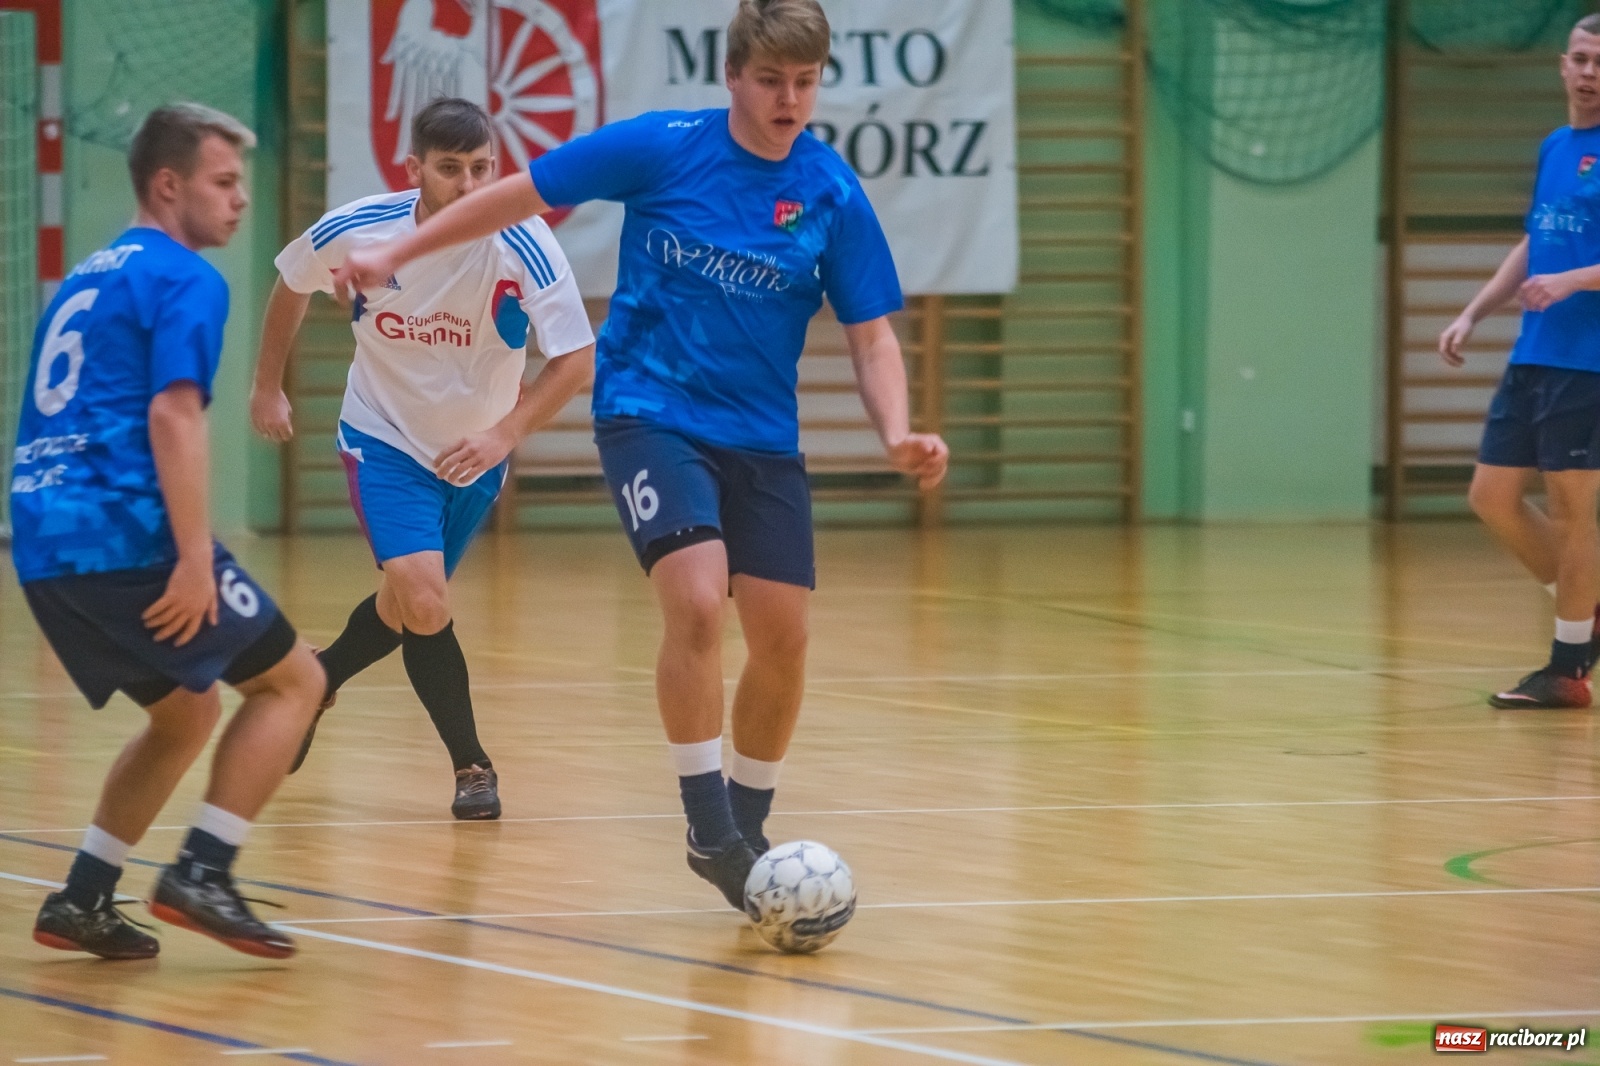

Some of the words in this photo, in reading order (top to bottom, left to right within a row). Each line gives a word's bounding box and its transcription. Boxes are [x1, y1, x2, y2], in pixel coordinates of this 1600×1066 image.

[664, 27, 946, 88] MSTO
[375, 312, 472, 347] Gianni
[406, 311, 472, 328] CUKIERNIA
[34, 288, 99, 417] 6
[621, 469, 659, 532] 16
[220, 568, 259, 618] 6
